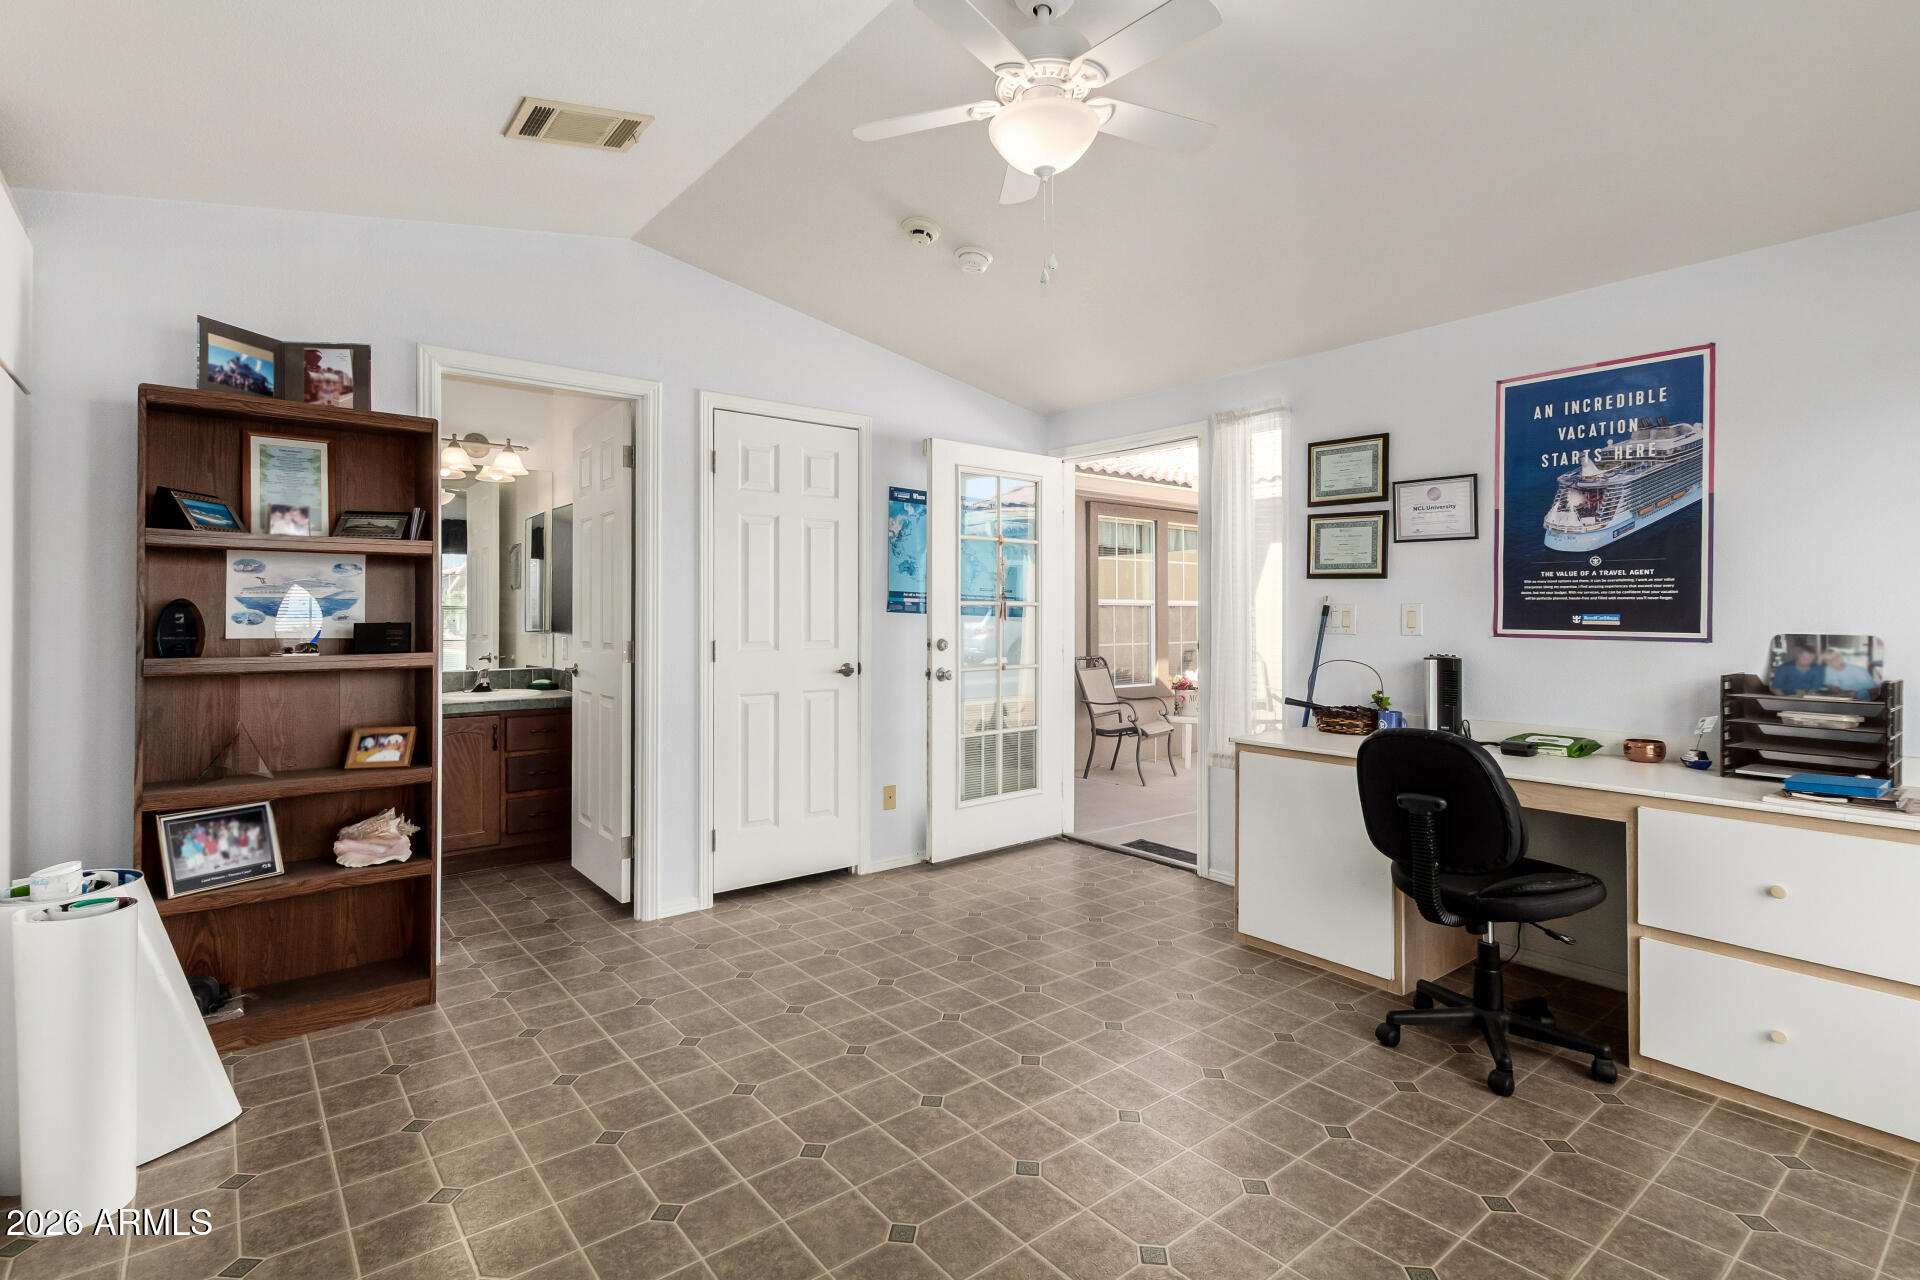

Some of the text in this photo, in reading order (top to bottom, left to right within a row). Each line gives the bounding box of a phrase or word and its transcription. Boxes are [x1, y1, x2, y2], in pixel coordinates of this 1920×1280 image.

[1534, 386, 1667, 420] AN INCREDIBLE
[1558, 418, 1638, 440] VACATION
[1541, 442, 1656, 468] STARTS HERE
